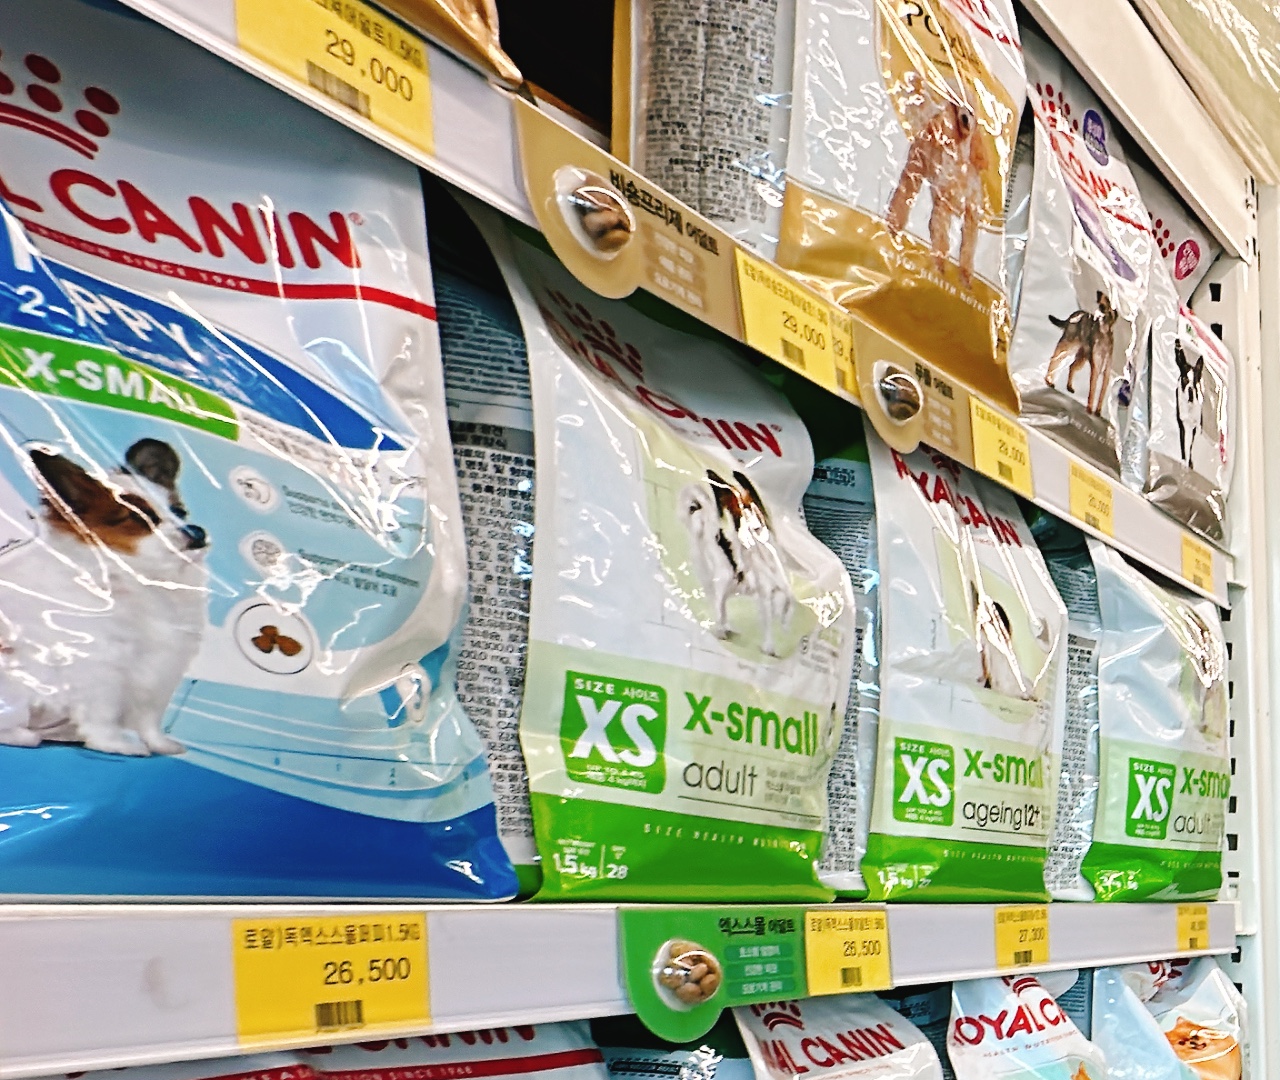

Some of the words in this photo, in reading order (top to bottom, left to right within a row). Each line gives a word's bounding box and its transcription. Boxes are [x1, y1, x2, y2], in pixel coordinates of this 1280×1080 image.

[325, 28, 414, 102] 29,000
[49, 167, 362, 270] CANIN
[573, 677, 616, 696] SIZE
[567, 694, 659, 768] XS
[900, 742, 926, 754] SIZE
[682, 760, 758, 797] adult
[898, 751, 953, 808] XS
[1131, 774, 1172, 822] XS
[719, 916, 766, 936] 엑스스몰
[842, 939, 882, 957] 26,500
[323, 957, 412, 985] 26,500
[799, 1023, 906, 1069] CANIN
